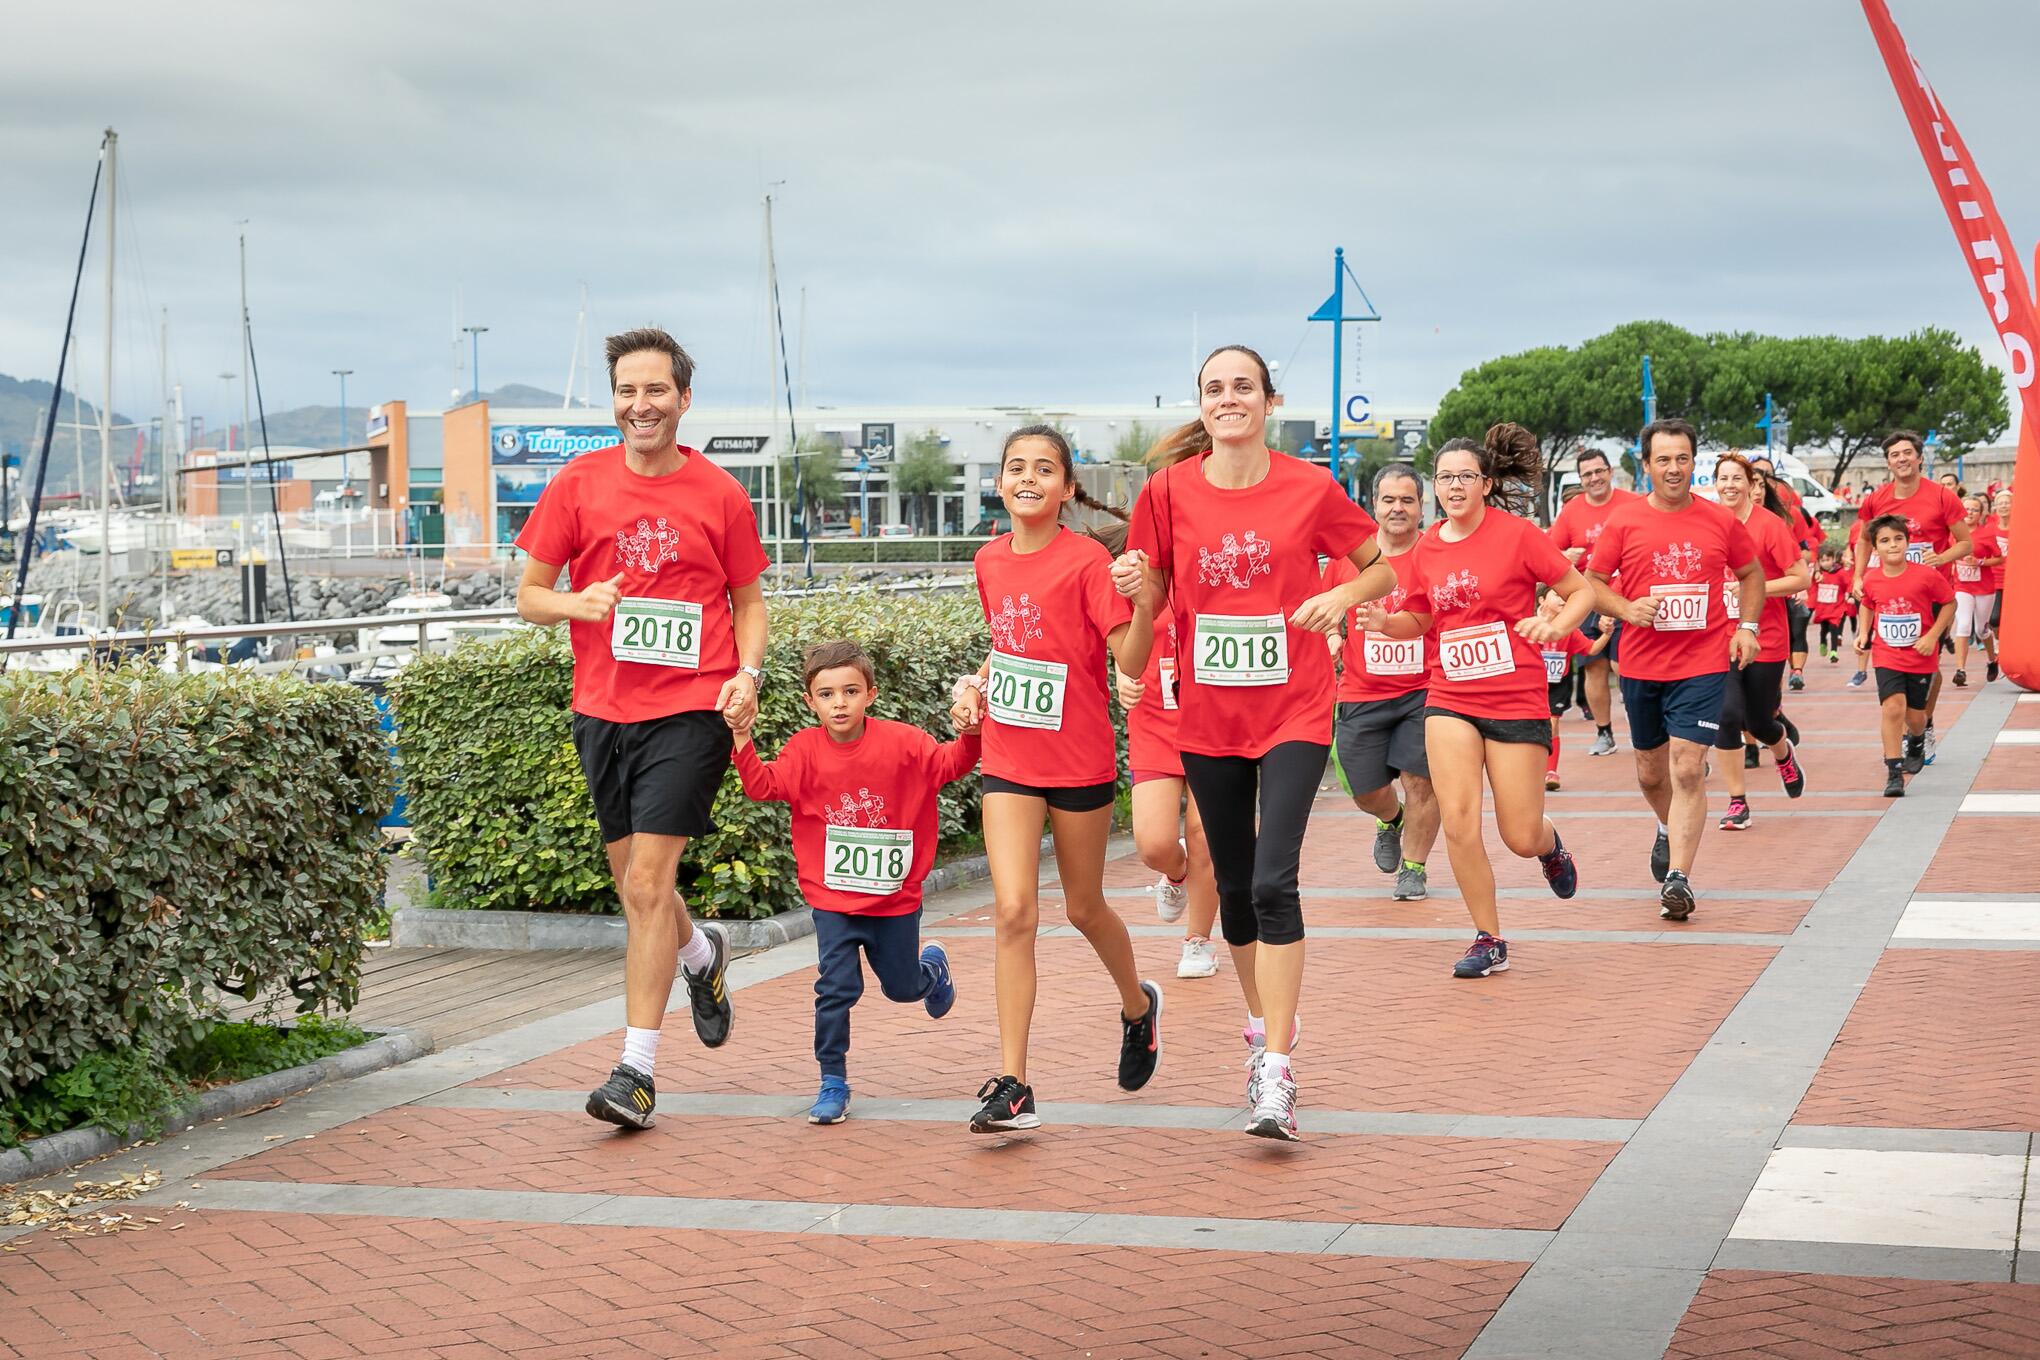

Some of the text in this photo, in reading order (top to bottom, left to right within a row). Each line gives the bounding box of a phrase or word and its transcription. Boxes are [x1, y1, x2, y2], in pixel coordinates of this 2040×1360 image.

[1346, 395, 1371, 423] C
[526, 431, 620, 456] Tarpoon
[1659, 598, 1702, 620] 3001
[622, 616, 693, 652] 2018
[1883, 623, 1917, 639] 1002
[1204, 635, 1278, 669] 2018
[1371, 643, 1414, 663] 3001
[1448, 637, 1502, 668] 3001
[991, 671, 1054, 713] 2018
[834, 844, 904, 879] 2018
